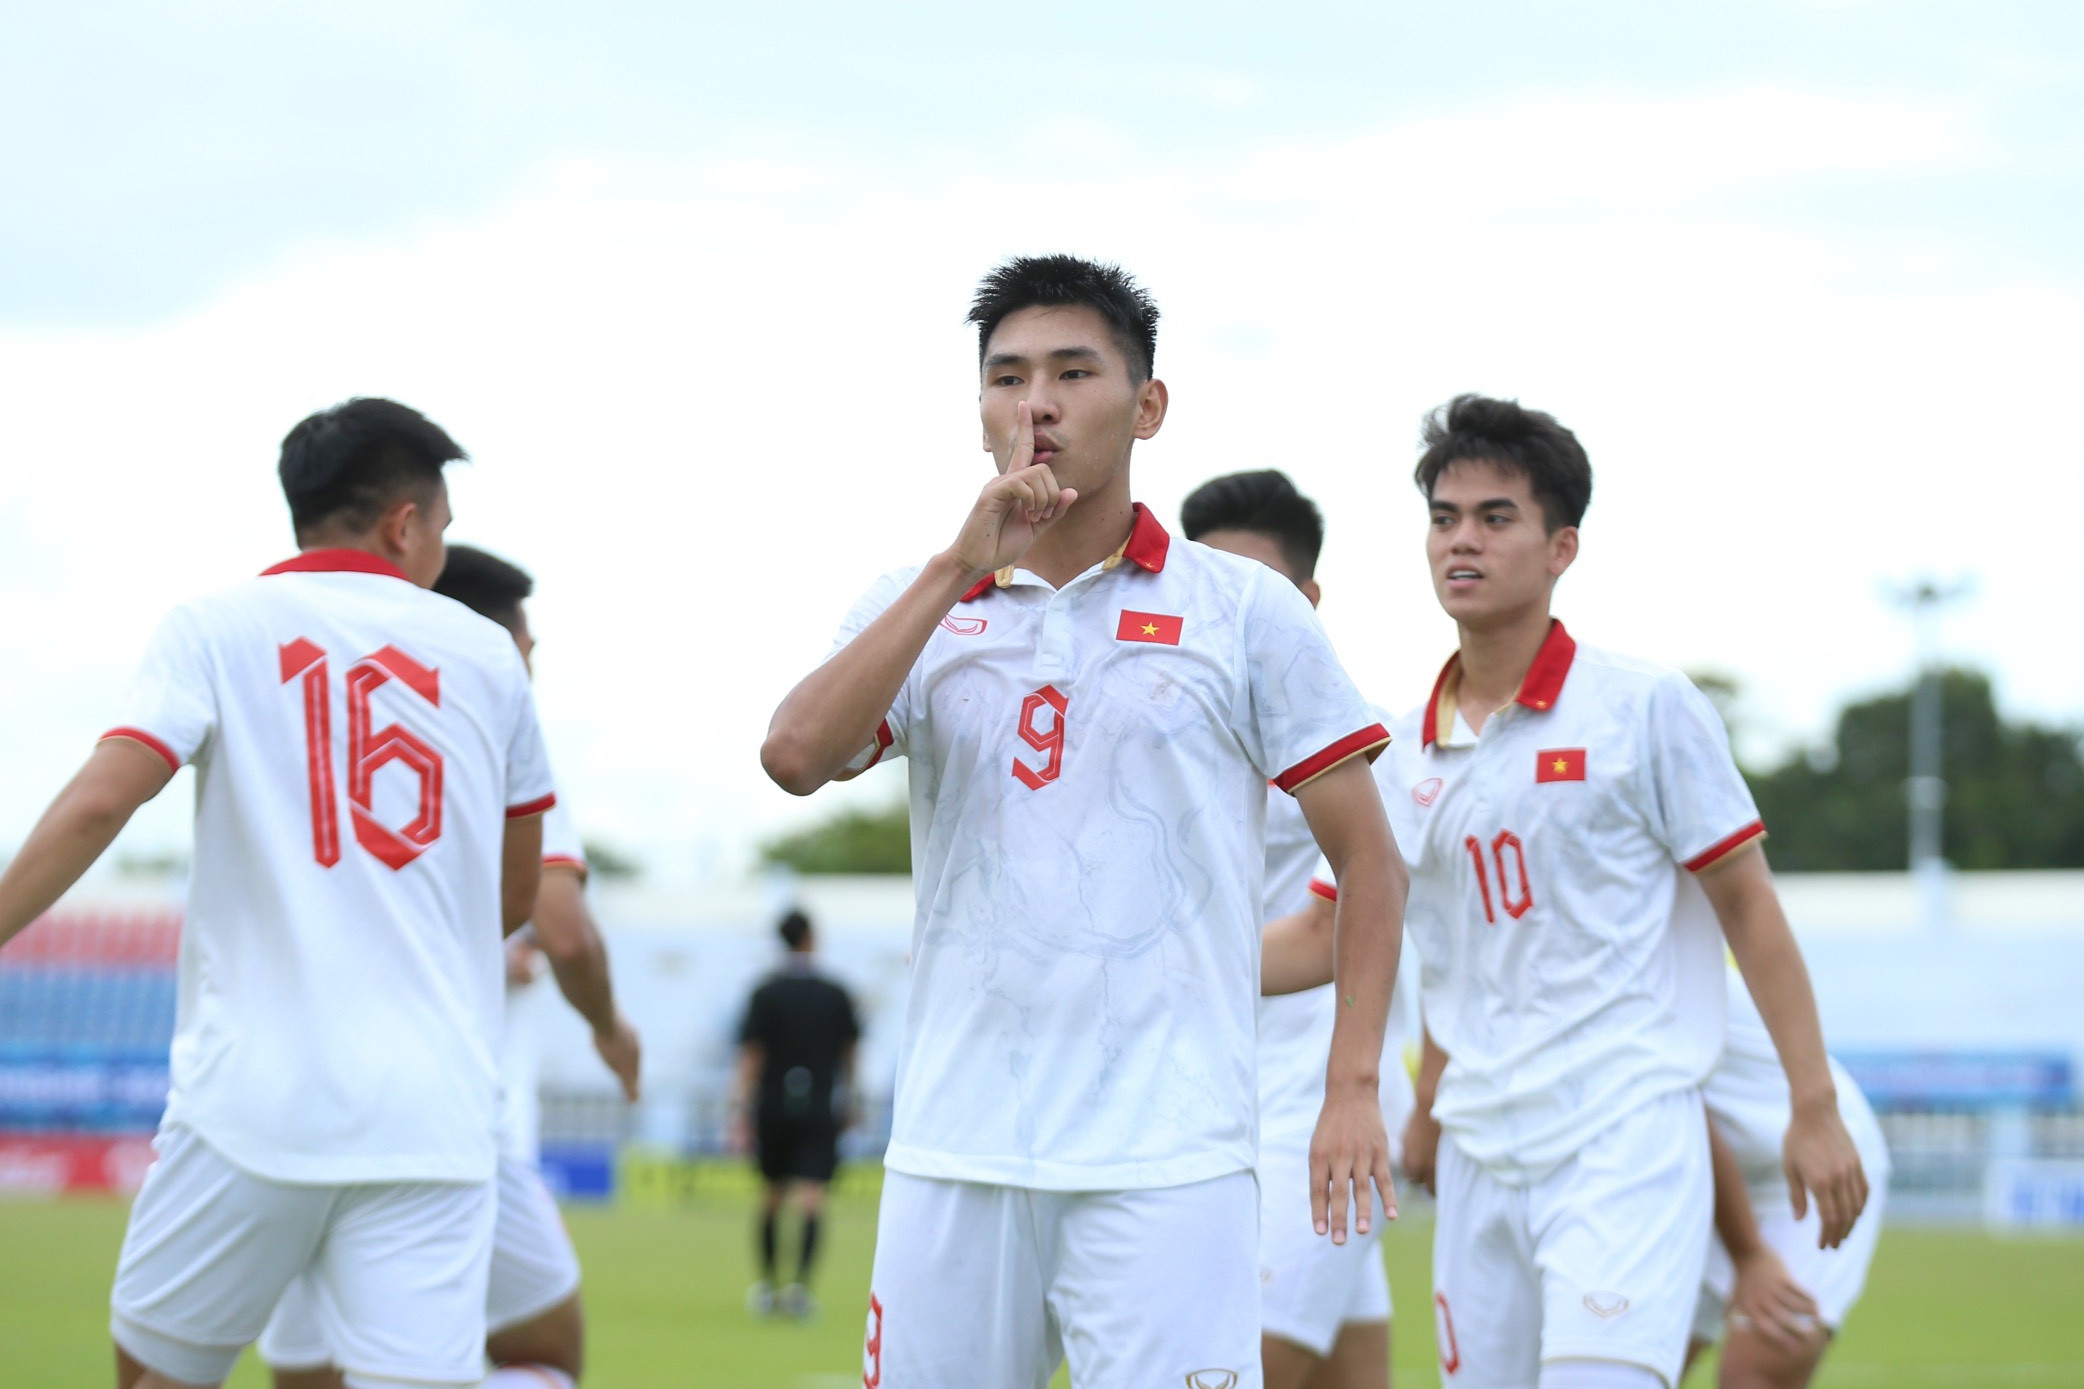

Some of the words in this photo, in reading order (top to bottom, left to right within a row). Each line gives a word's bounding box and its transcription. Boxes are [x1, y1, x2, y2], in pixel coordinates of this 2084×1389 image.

[278, 635, 443, 871] 16
[1011, 684, 1069, 791] 9
[1464, 828, 1533, 924] 10
